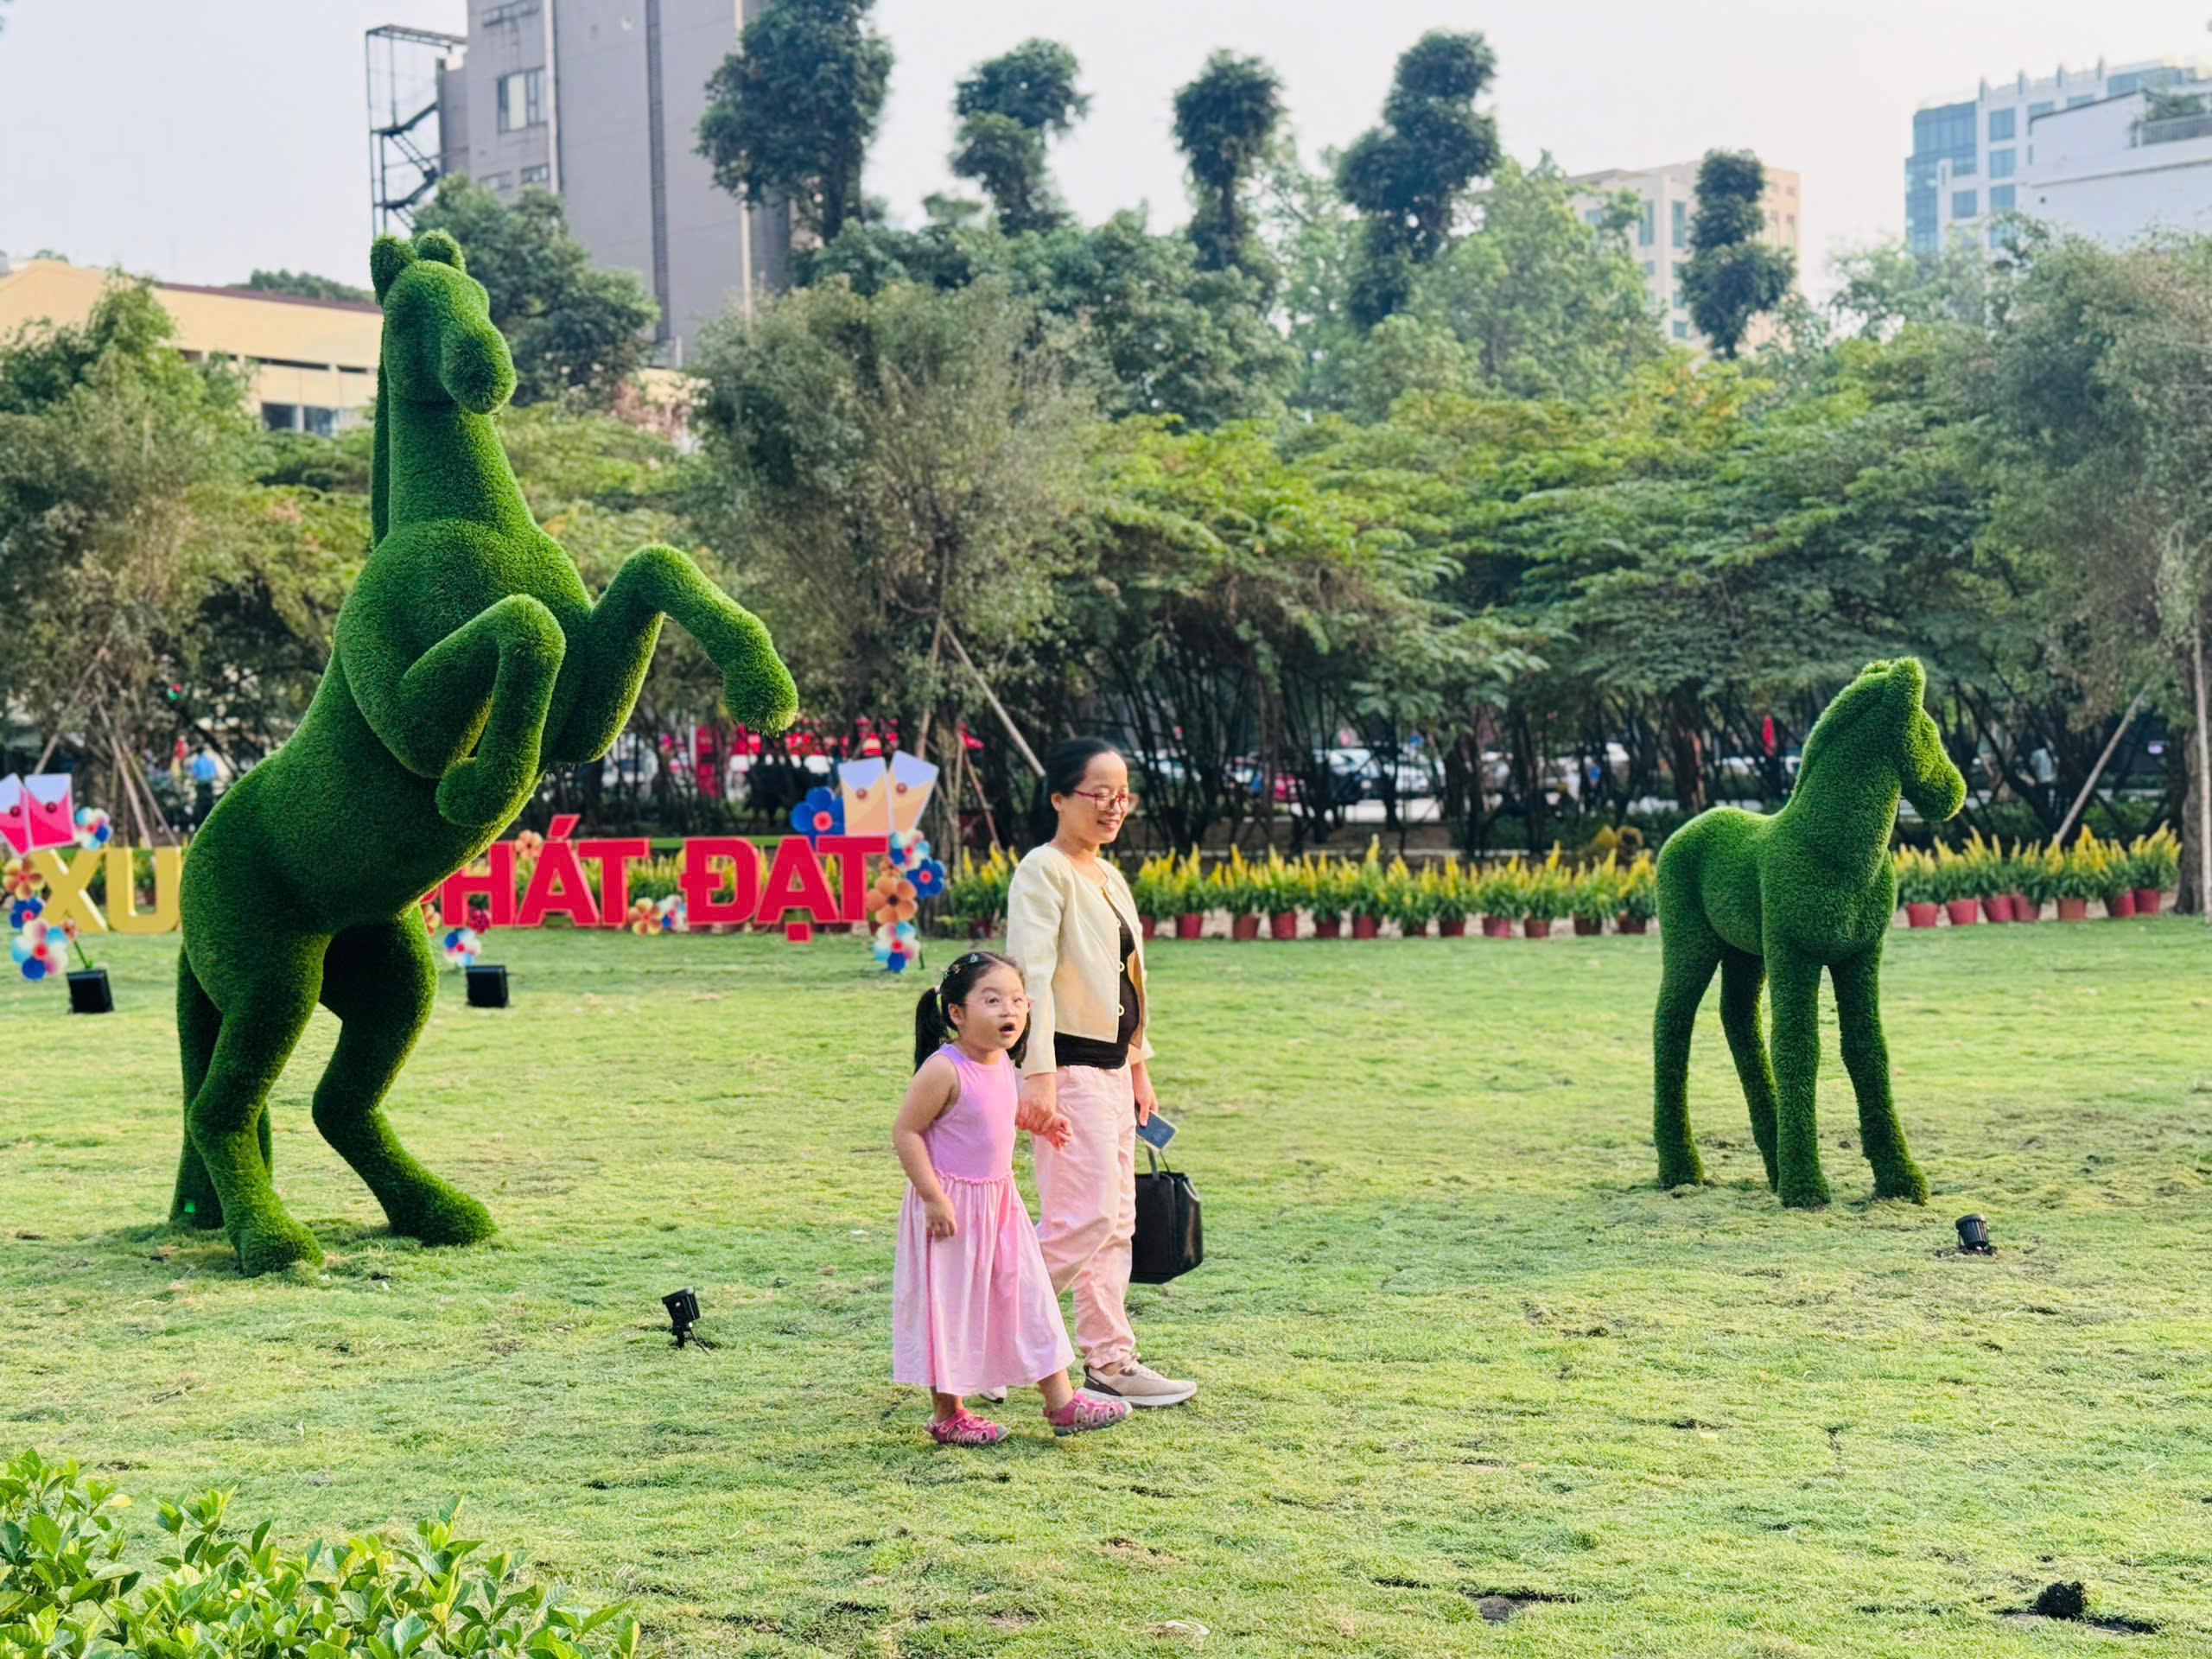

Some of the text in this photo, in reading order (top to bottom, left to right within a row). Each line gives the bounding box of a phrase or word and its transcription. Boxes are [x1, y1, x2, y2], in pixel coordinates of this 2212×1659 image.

[31, 813, 889, 944] XU HÁT ĐẠT
